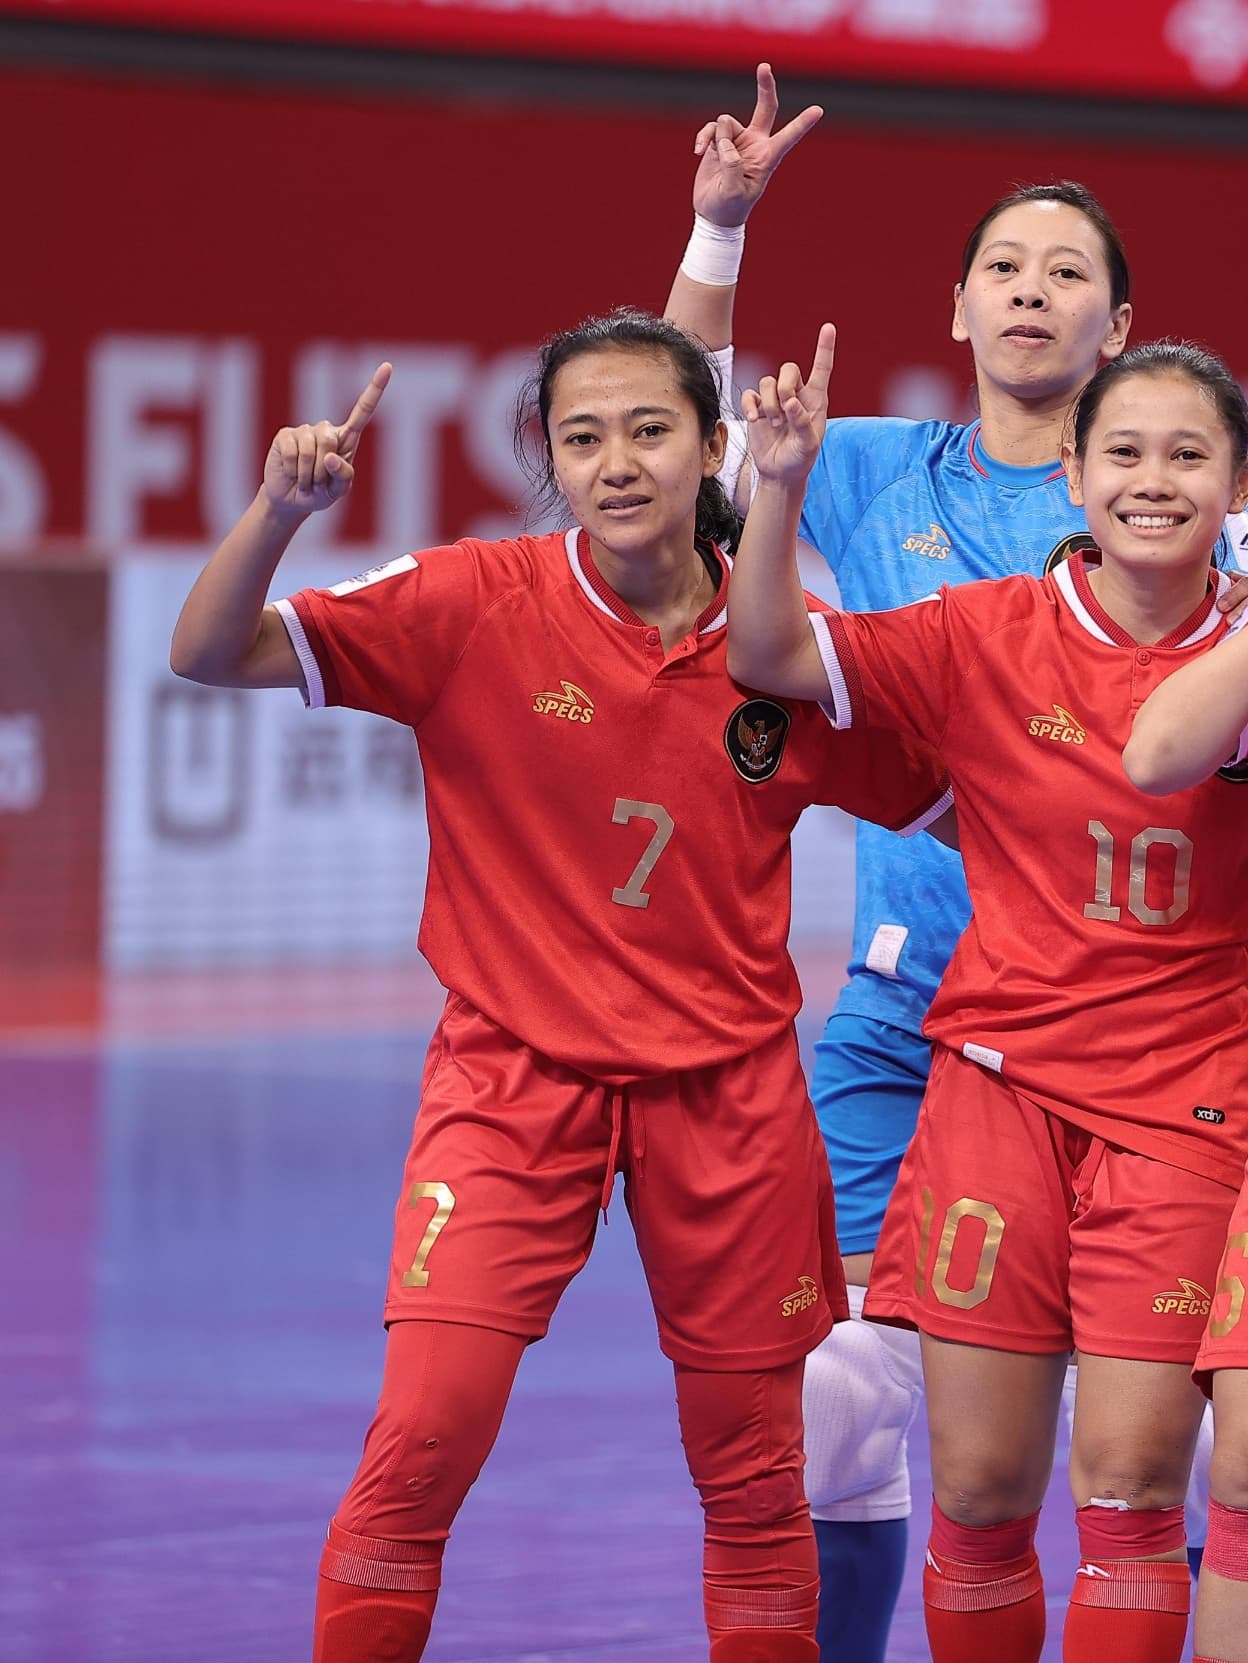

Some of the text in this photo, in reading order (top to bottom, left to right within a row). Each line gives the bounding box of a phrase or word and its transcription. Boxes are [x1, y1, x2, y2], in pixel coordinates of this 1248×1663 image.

[902, 536, 950, 561] SPECS
[532, 696, 595, 724] SPECS
[1028, 719, 1087, 745] SPECS
[611, 797, 675, 909] 7
[1084, 819, 1194, 926] 10
[401, 1180, 457, 1289] 7
[781, 1286, 819, 1317] SPECS
[1151, 1298, 1211, 1316] SPECS
